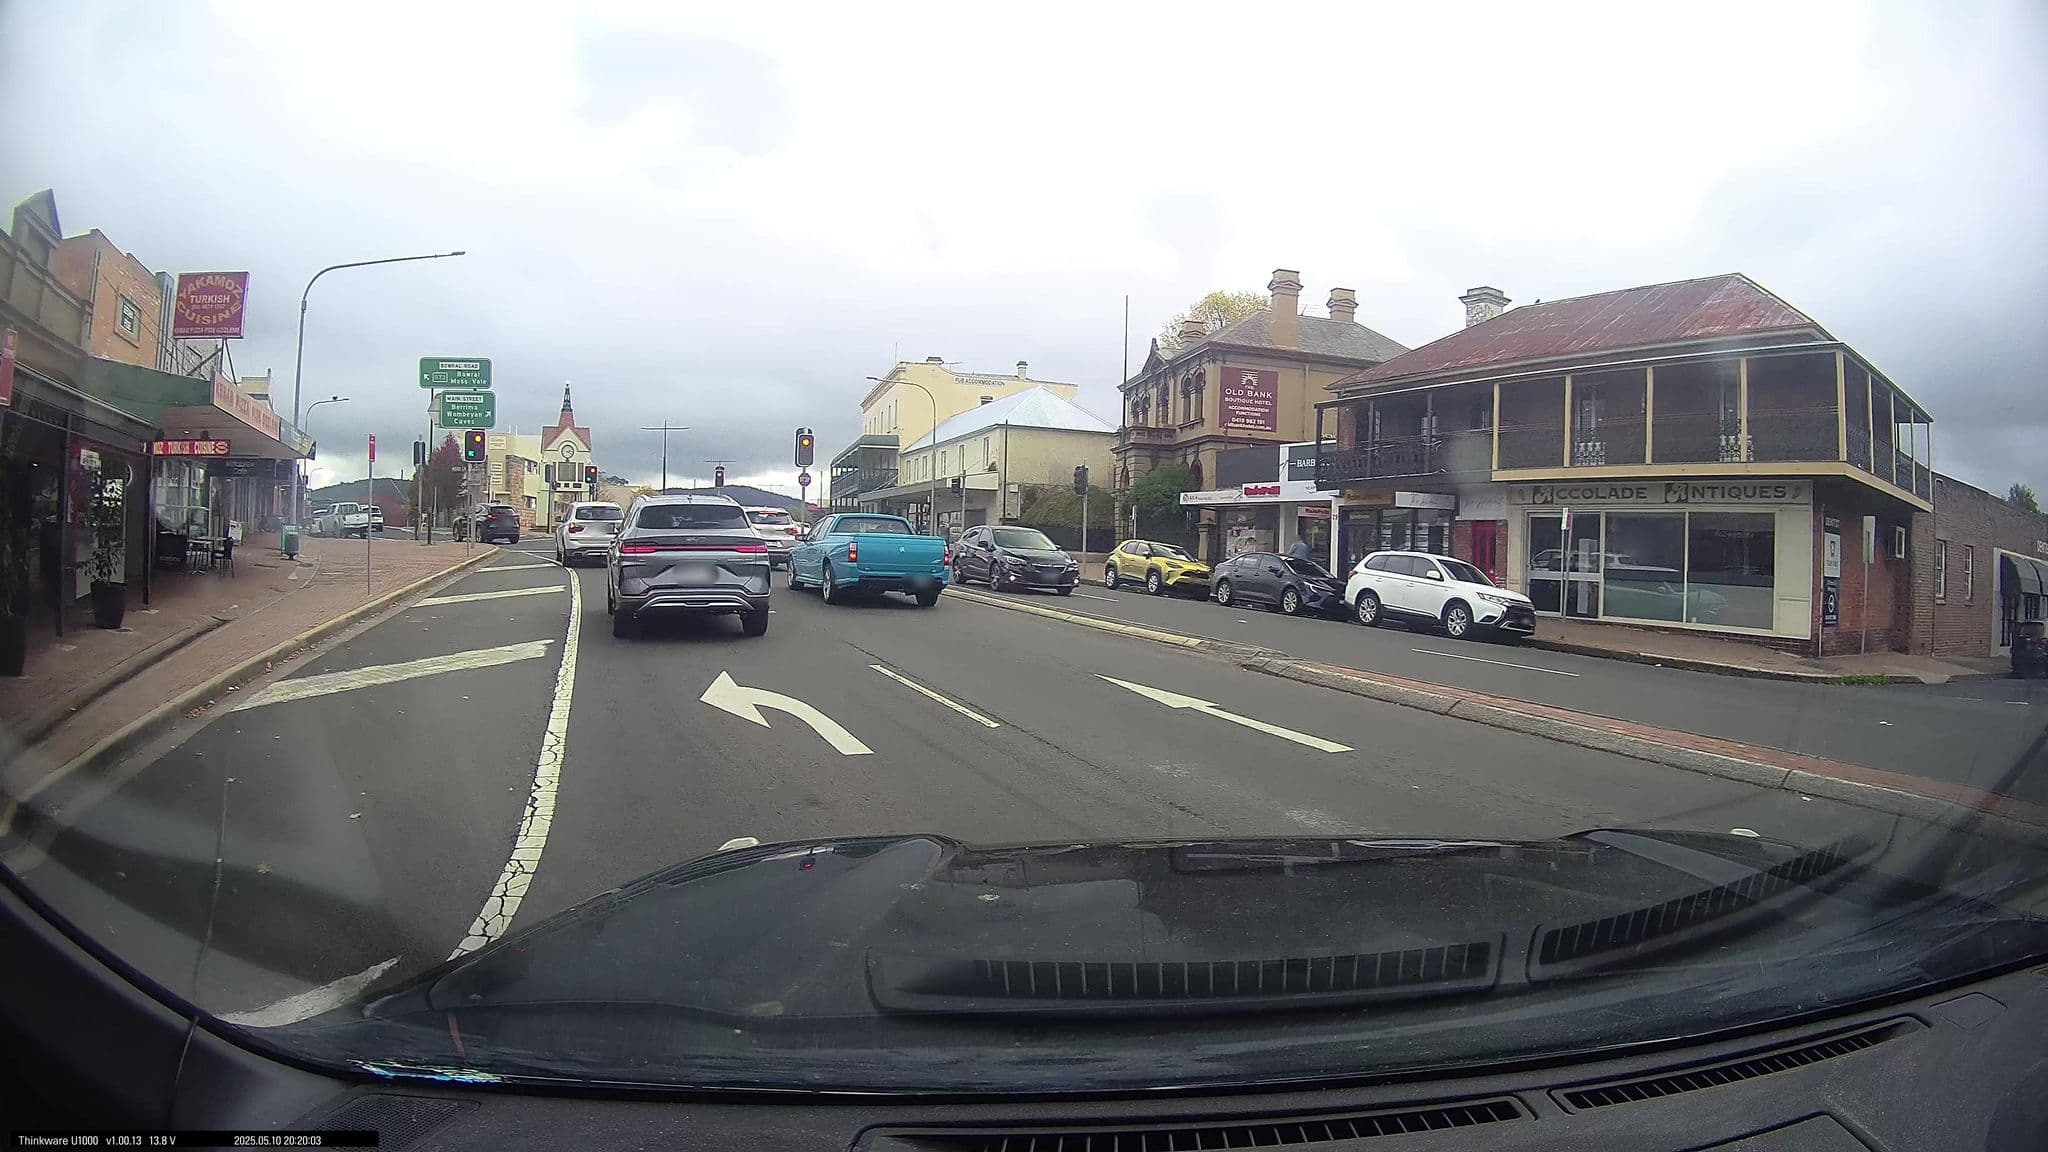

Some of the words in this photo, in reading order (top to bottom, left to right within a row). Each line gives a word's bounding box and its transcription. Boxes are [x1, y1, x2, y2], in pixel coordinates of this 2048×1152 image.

[178, 275, 244, 299] YAKAMOZ
[189, 294, 230, 304] TURKISH
[176, 300, 242, 325] CUISINE
[1225, 388, 1244, 396] OLD
[1247, 390, 1272, 399] BANK
[168, 441, 190, 454] TURKISH
[194, 441, 215, 454] CUISINE
